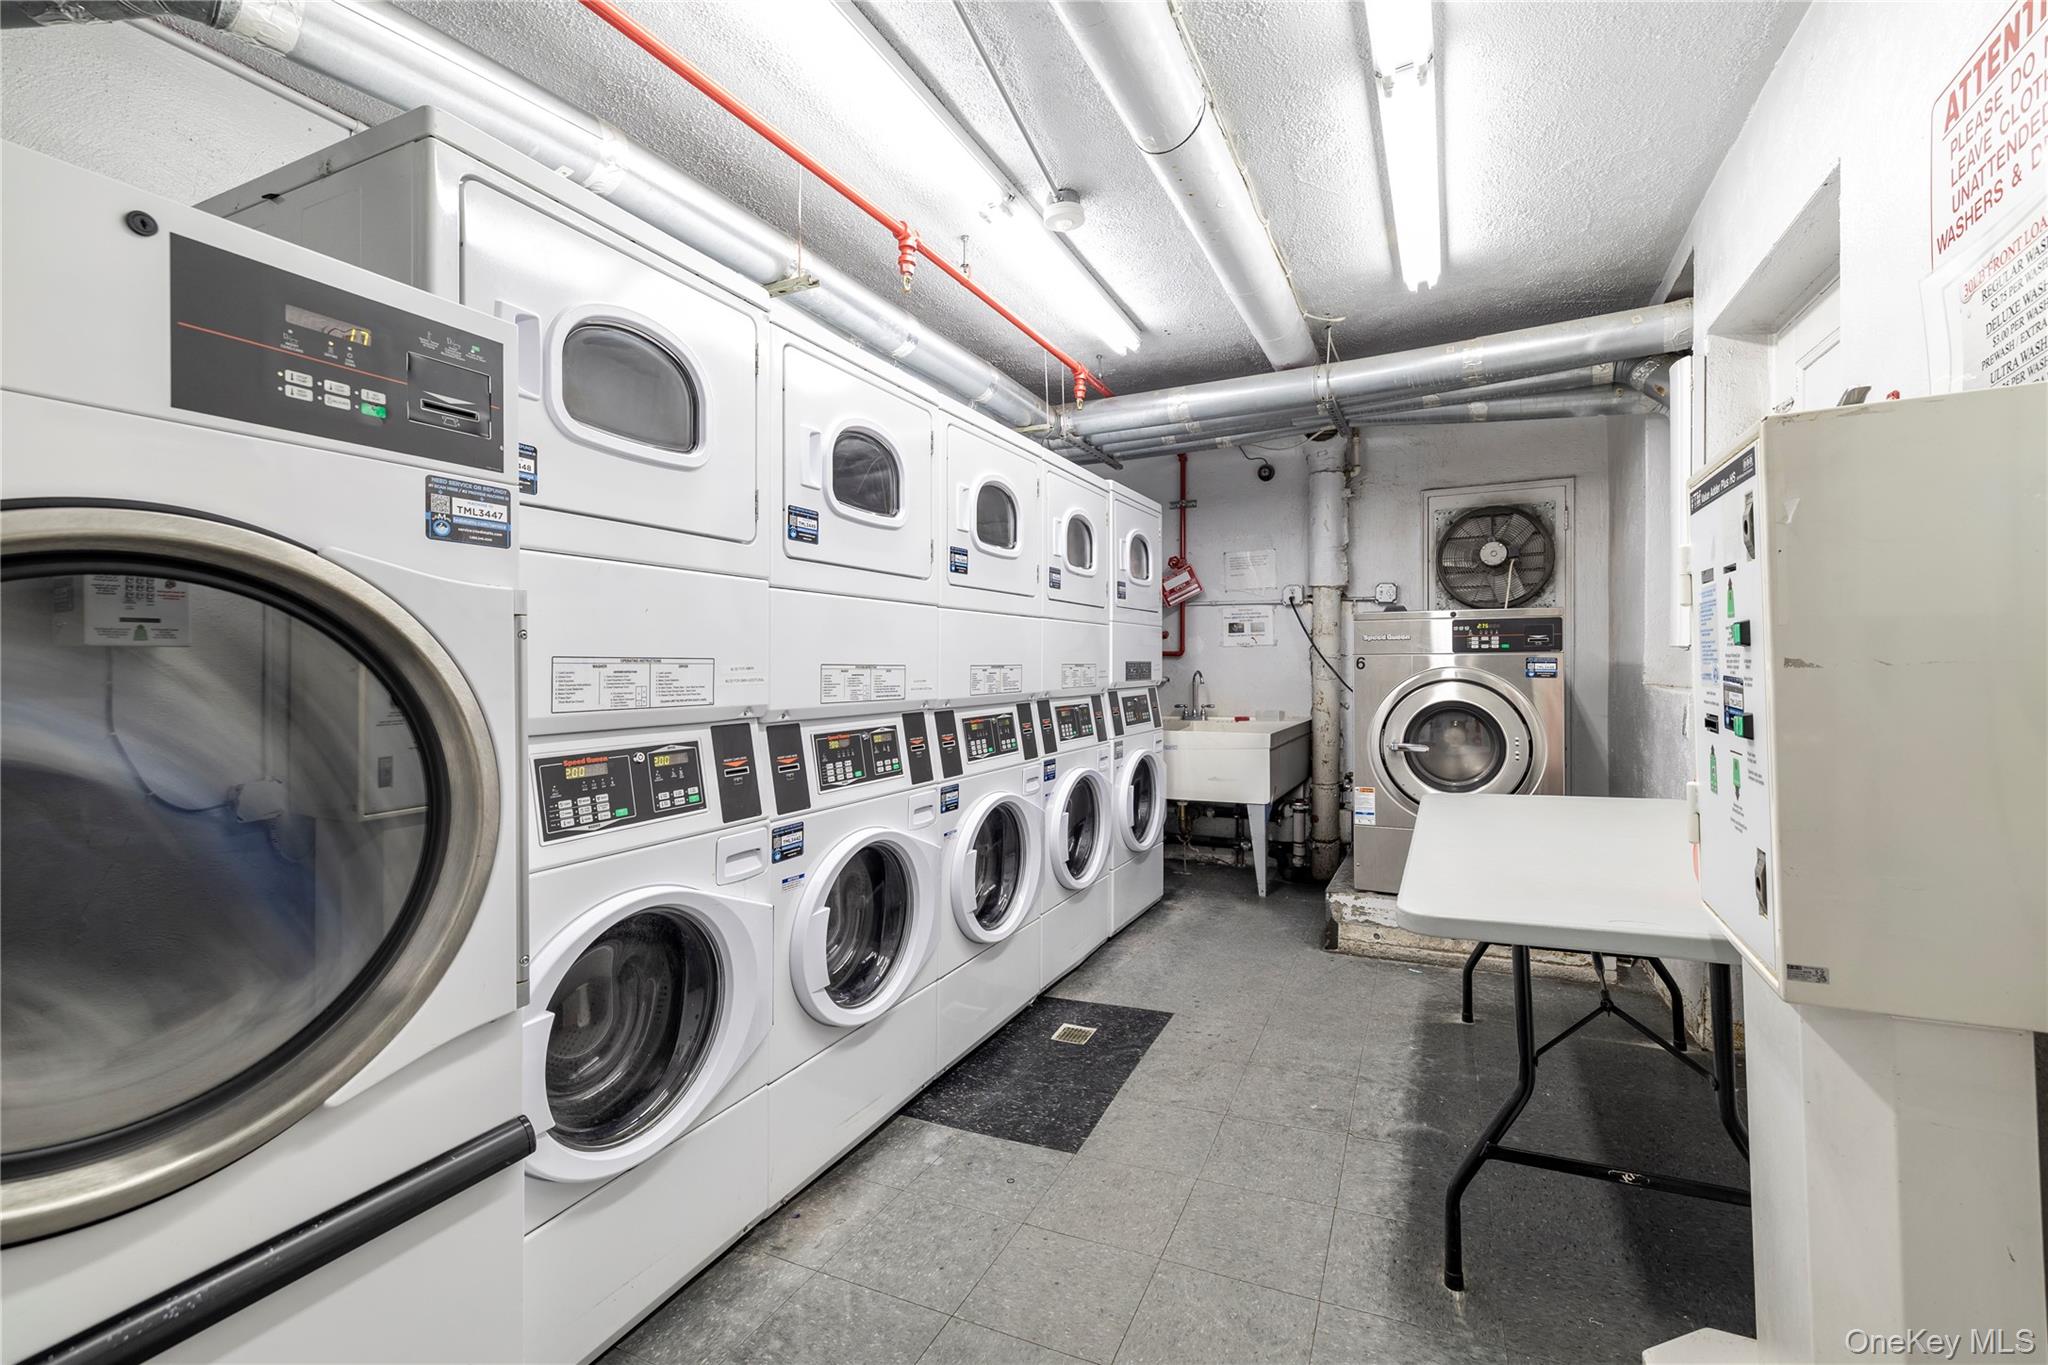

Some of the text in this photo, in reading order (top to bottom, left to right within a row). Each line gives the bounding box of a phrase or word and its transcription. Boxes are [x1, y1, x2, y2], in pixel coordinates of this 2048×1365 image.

[1950, 52, 2035, 161] PLEASE DO
[1951, 126, 1992, 188] LEAVE
[1937, 178, 2004, 255] WASHERS
[2011, 163, 2022, 188] &
[1981, 258, 2024, 302] REGULAR
[1985, 299, 2021, 336] DELUXE
[2010, 316, 2025, 335] PER
[1981, 339, 2016, 371] PREWASH
[2020, 318, 2048, 344] EXTRA
[1990, 335, 2048, 384] ULTRA WASH
[448, 479, 473, 490] SERVICE
[456, 505, 503, 520] TML3447
[1356, 657, 1365, 669] 6
[563, 756, 608, 767] Speed Queen
